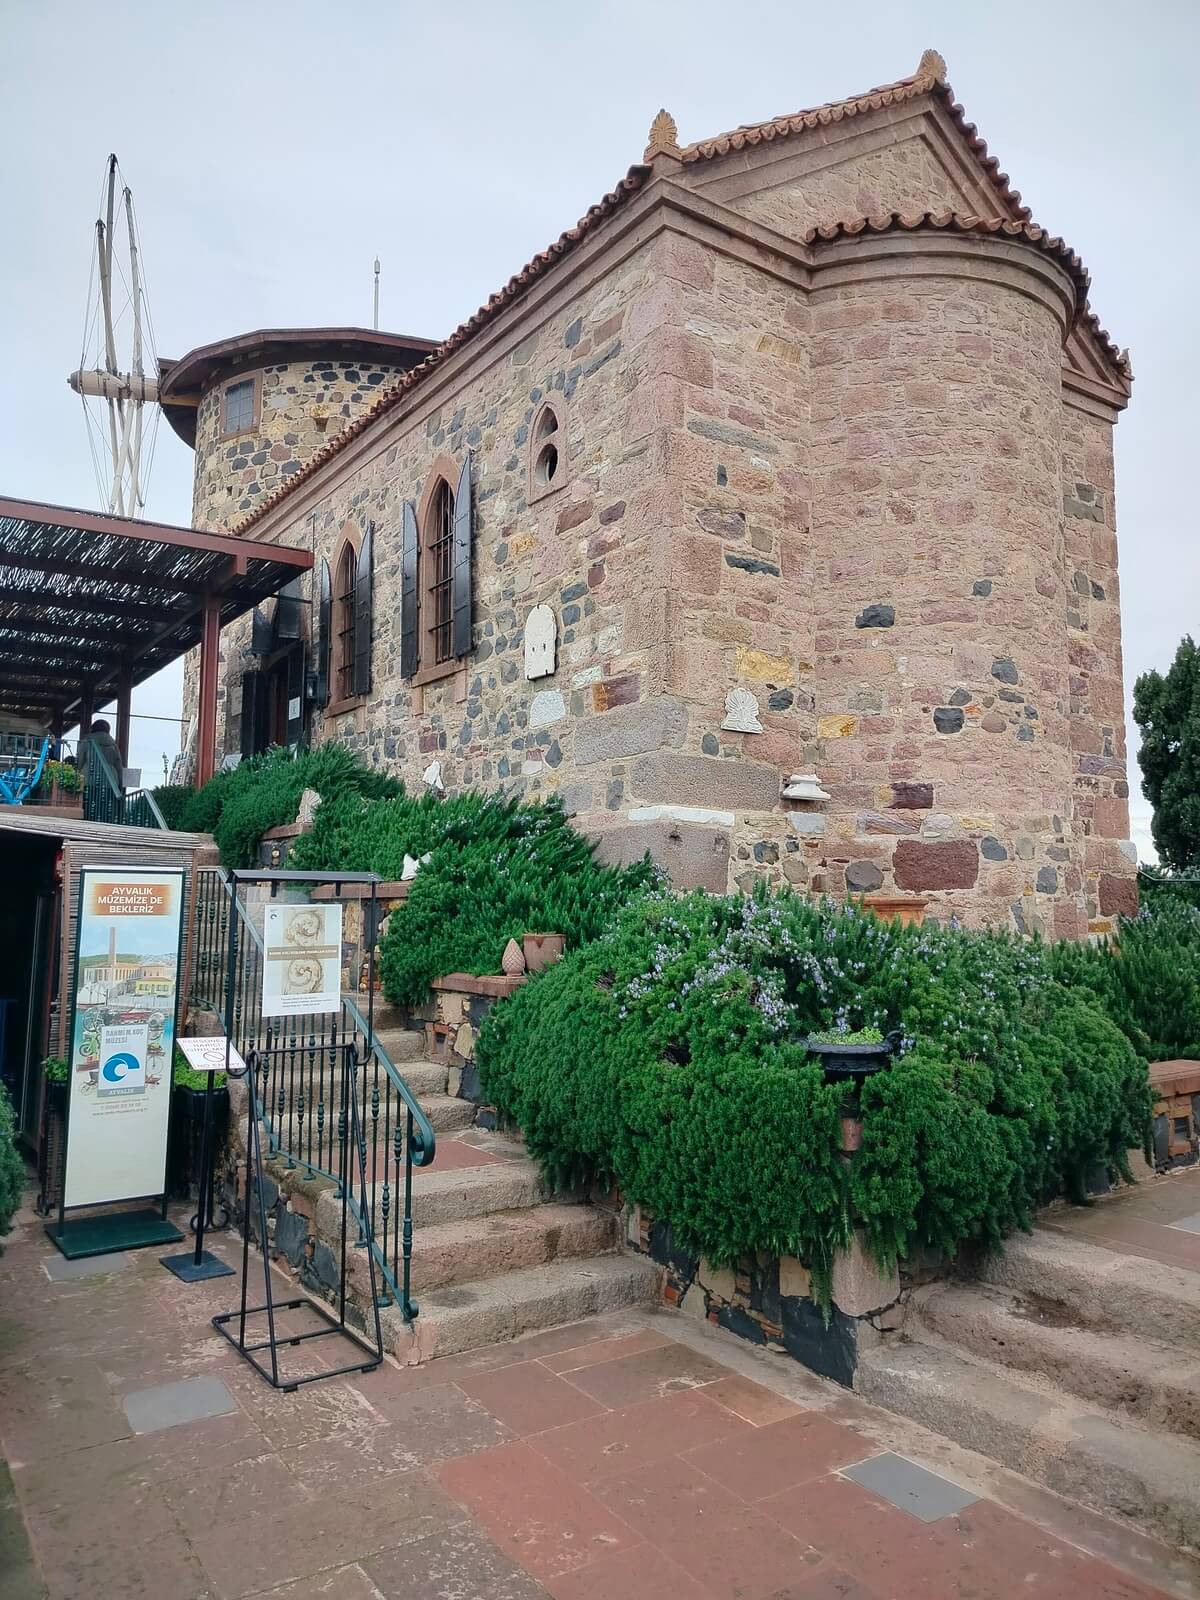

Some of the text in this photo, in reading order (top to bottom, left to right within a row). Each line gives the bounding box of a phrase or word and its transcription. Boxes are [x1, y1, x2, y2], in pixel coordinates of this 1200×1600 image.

[111, 887, 153, 895] AYVALIK
[98, 895, 164, 904] MÜZEMİZE DE
[109, 903, 154, 913] BEKLERİZ
